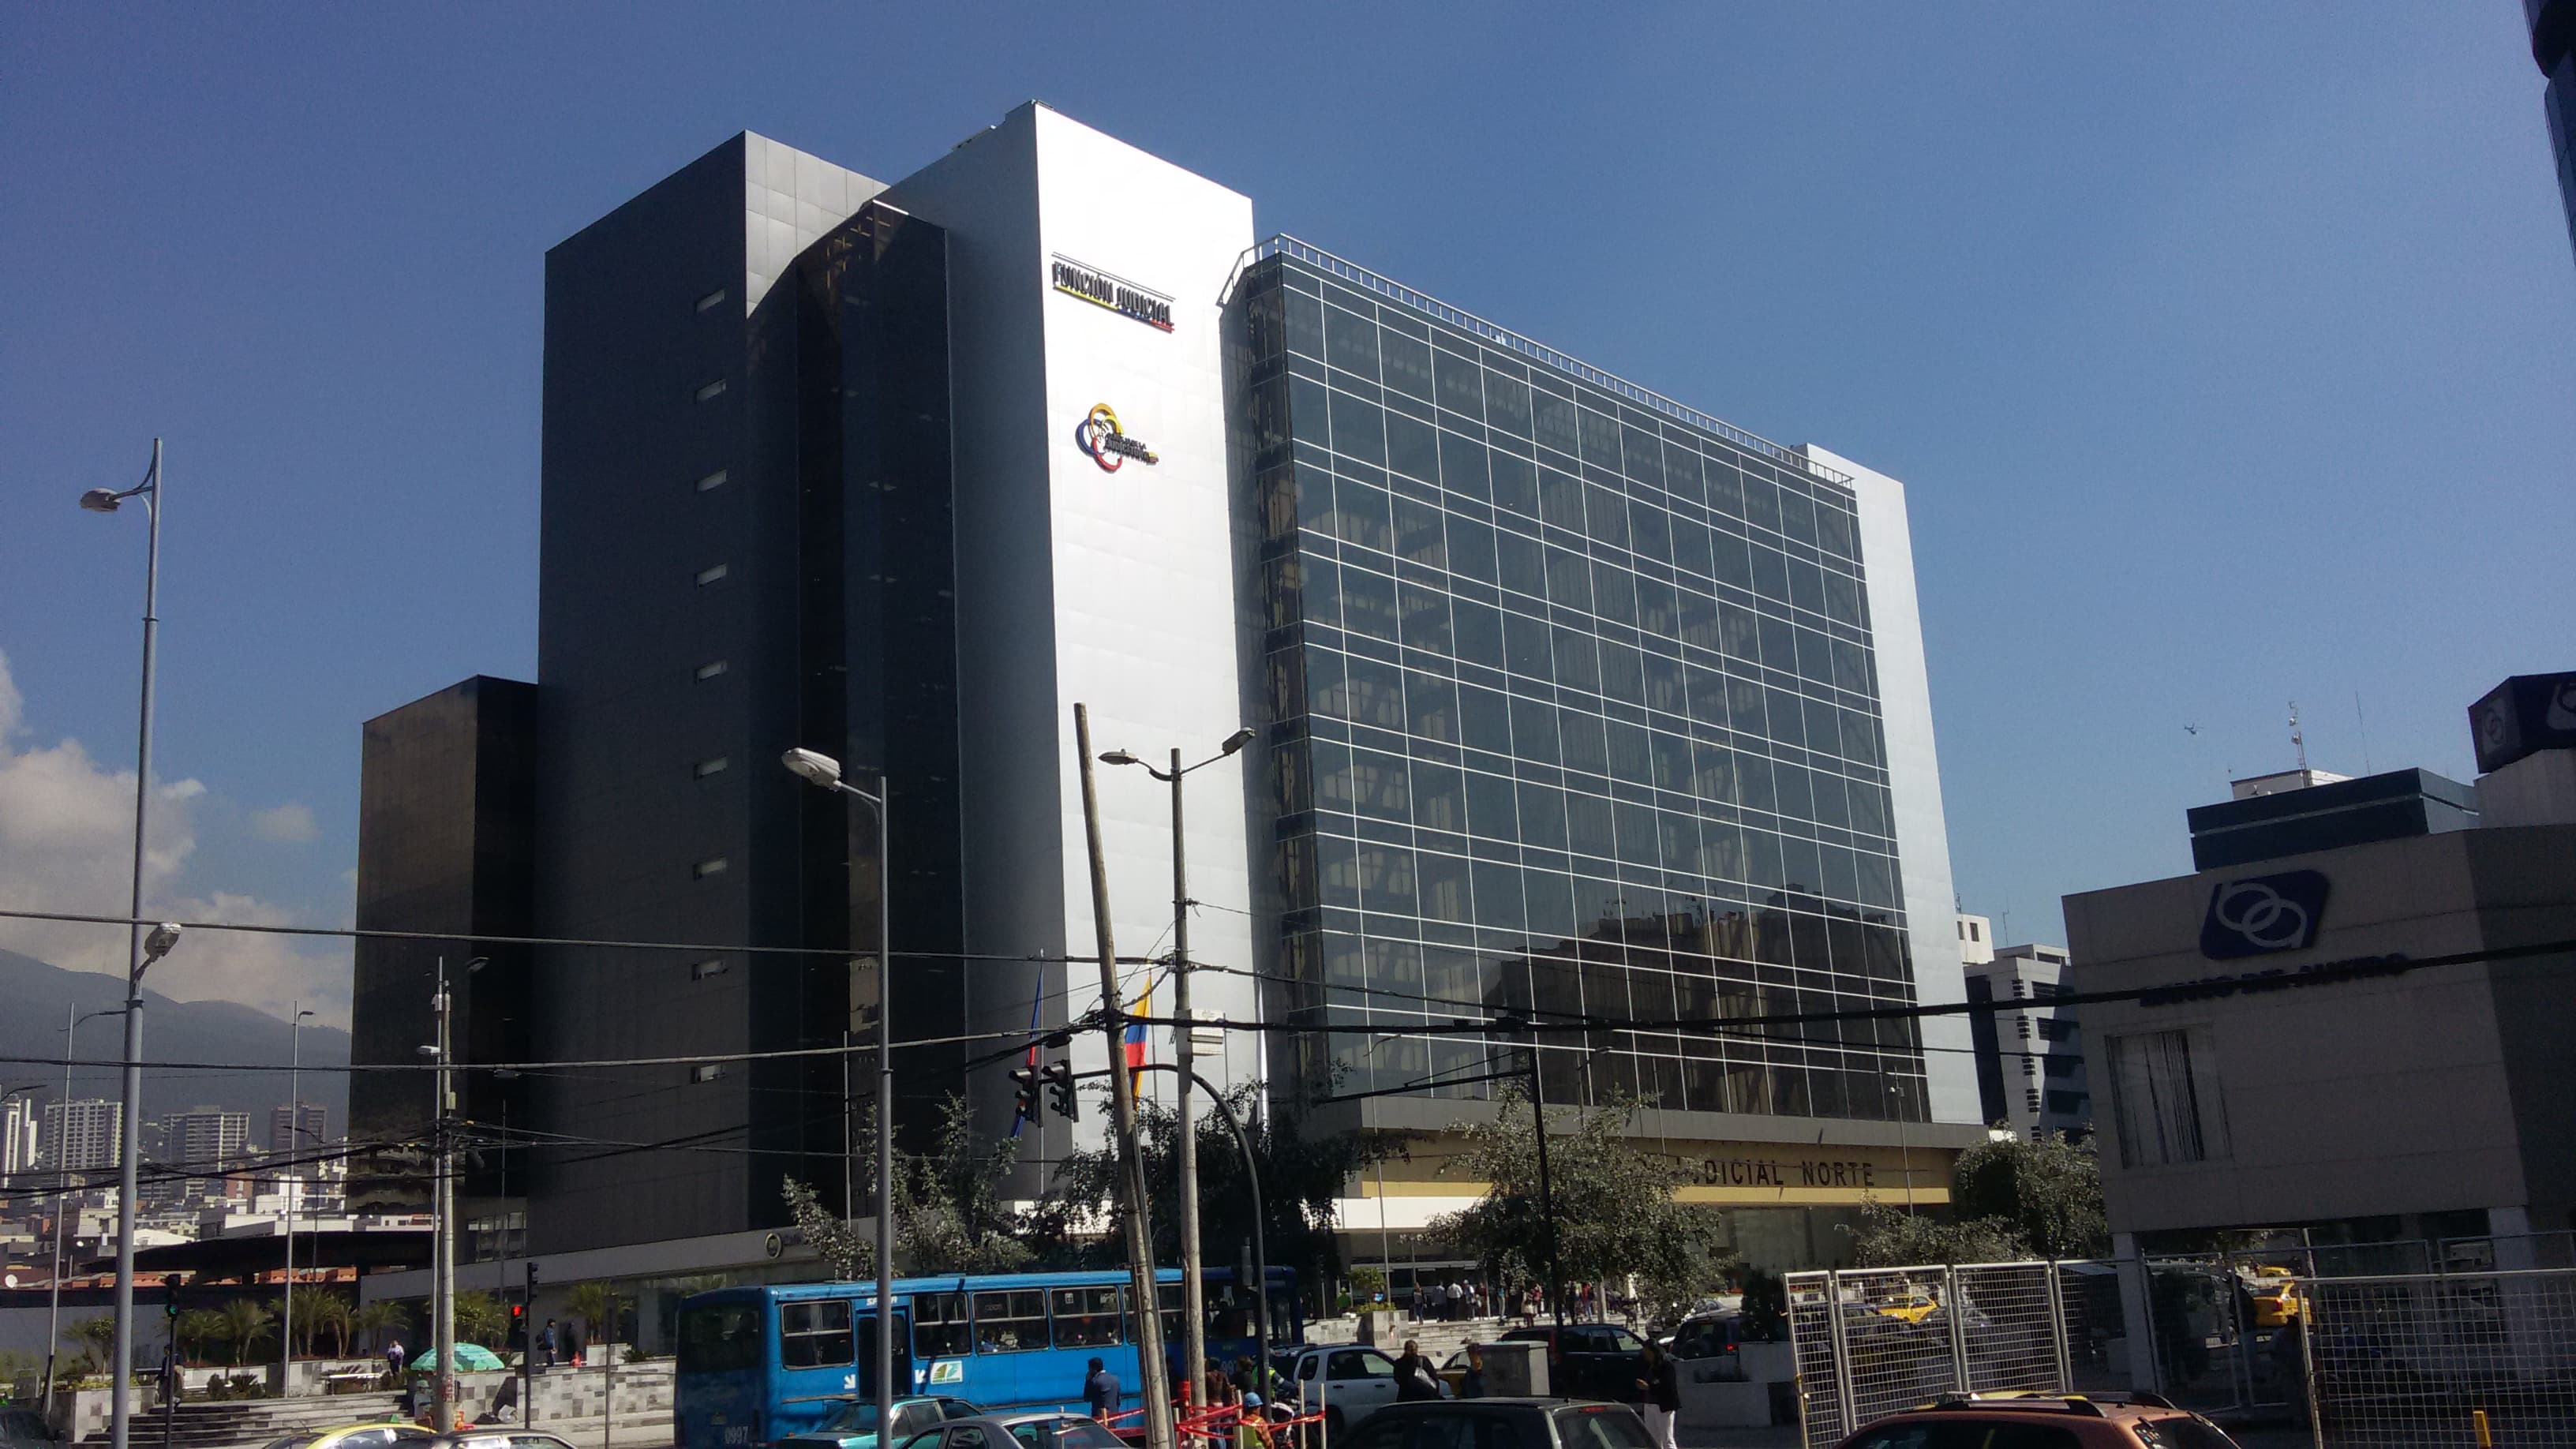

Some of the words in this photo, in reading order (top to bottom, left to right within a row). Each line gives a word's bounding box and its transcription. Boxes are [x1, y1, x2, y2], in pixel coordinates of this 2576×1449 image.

[1052, 261, 1114, 303] FUNCIÓN
[1116, 286, 1174, 326] JUDICIAL
[1802, 1160, 1875, 1187] NORTE
